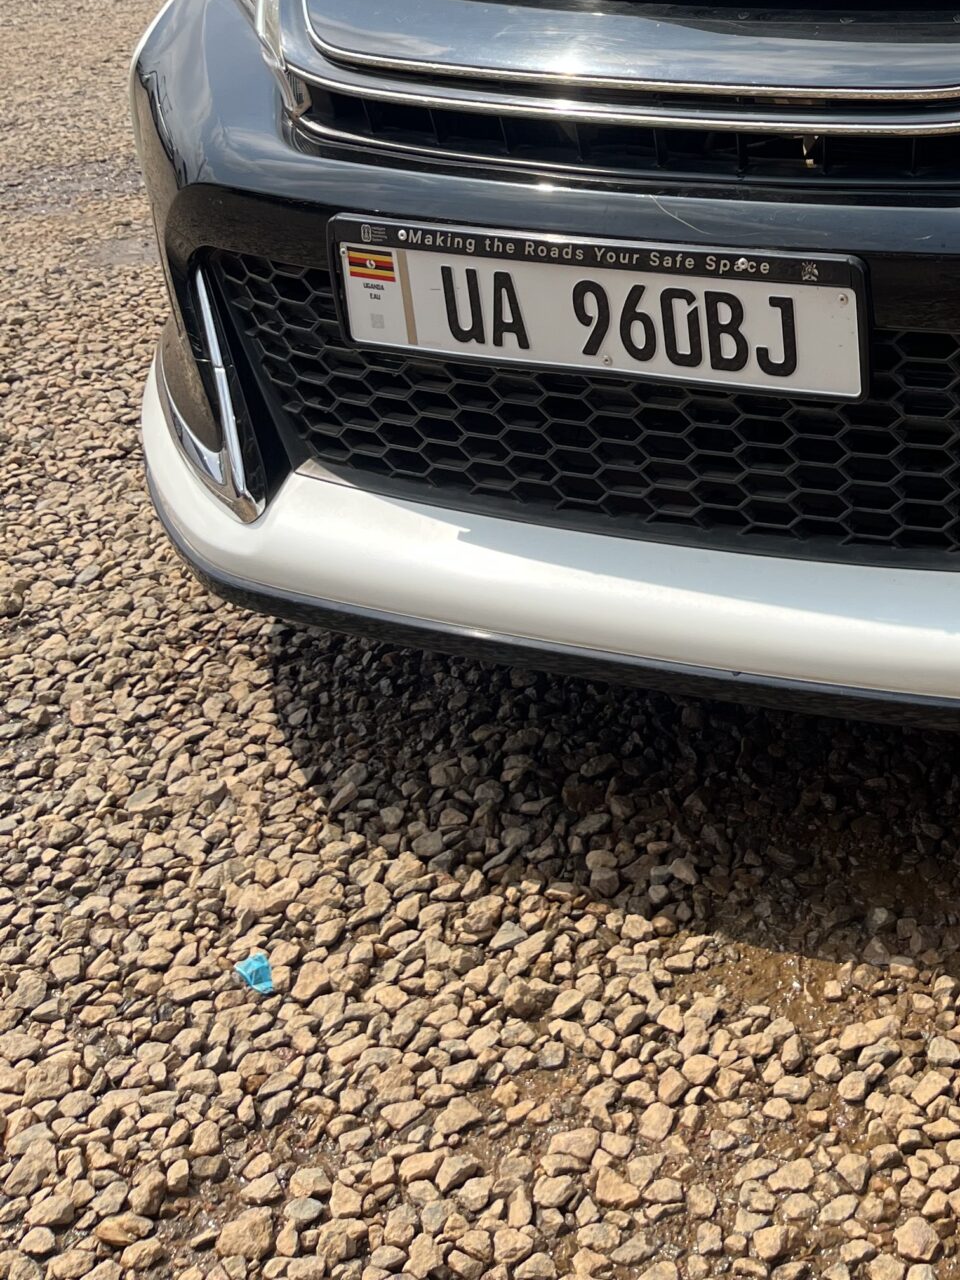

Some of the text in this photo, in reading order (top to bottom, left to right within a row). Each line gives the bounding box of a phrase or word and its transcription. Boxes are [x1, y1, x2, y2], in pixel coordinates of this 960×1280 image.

[408, 229, 476, 253] Making
[485, 238, 516, 254] the
[524, 241, 585, 260] Roads
[594, 247, 640, 265] Your
[649, 252, 695, 269] Safe
[362, 282, 385, 291] UGANDA
[369, 292, 381, 301] EAU
[440, 265, 797, 377] UA 960BJ
